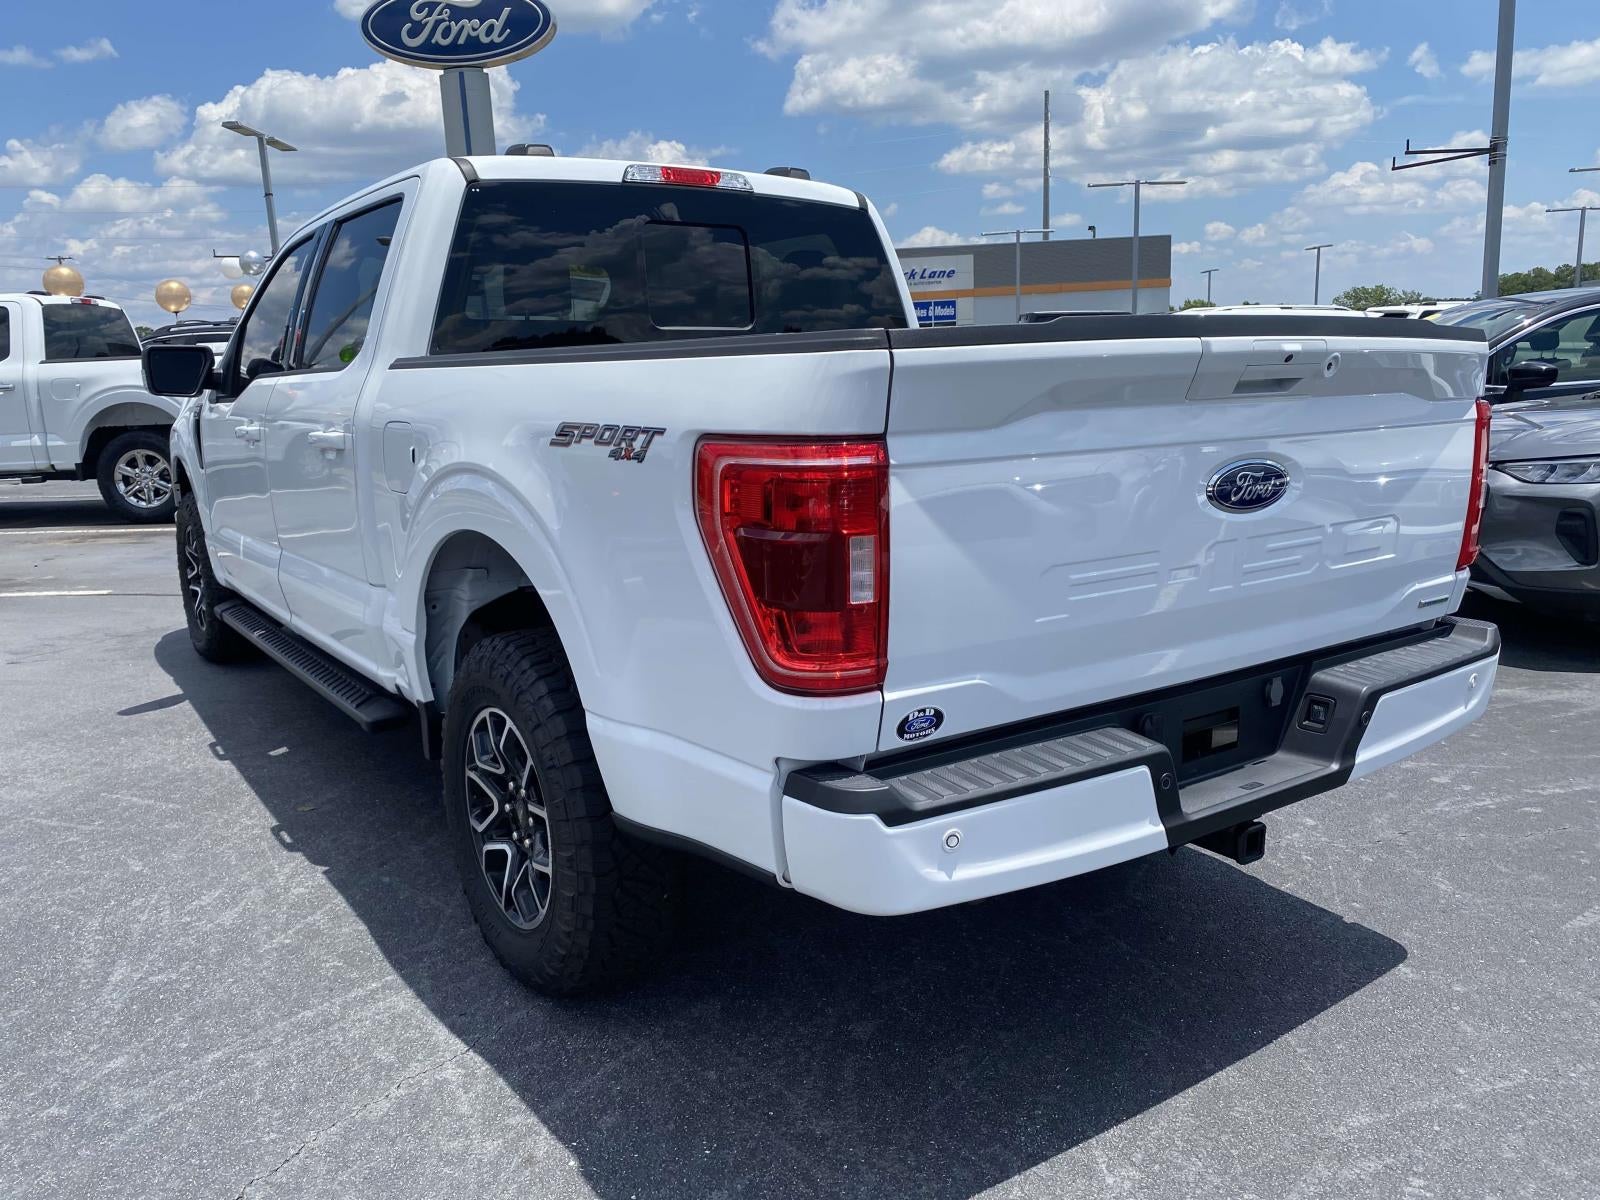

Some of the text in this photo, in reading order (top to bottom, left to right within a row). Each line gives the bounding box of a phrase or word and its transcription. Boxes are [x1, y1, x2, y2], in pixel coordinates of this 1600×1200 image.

[400, 0, 512, 47] Ford
[903, 268, 956, 280] rk Lane
[934, 305, 955, 316] Models
[549, 422, 667, 448] SPORT
[1230, 471, 1276, 502] Ford
[1036, 513, 1400, 622] F-150
[910, 718, 932, 730] Ford
